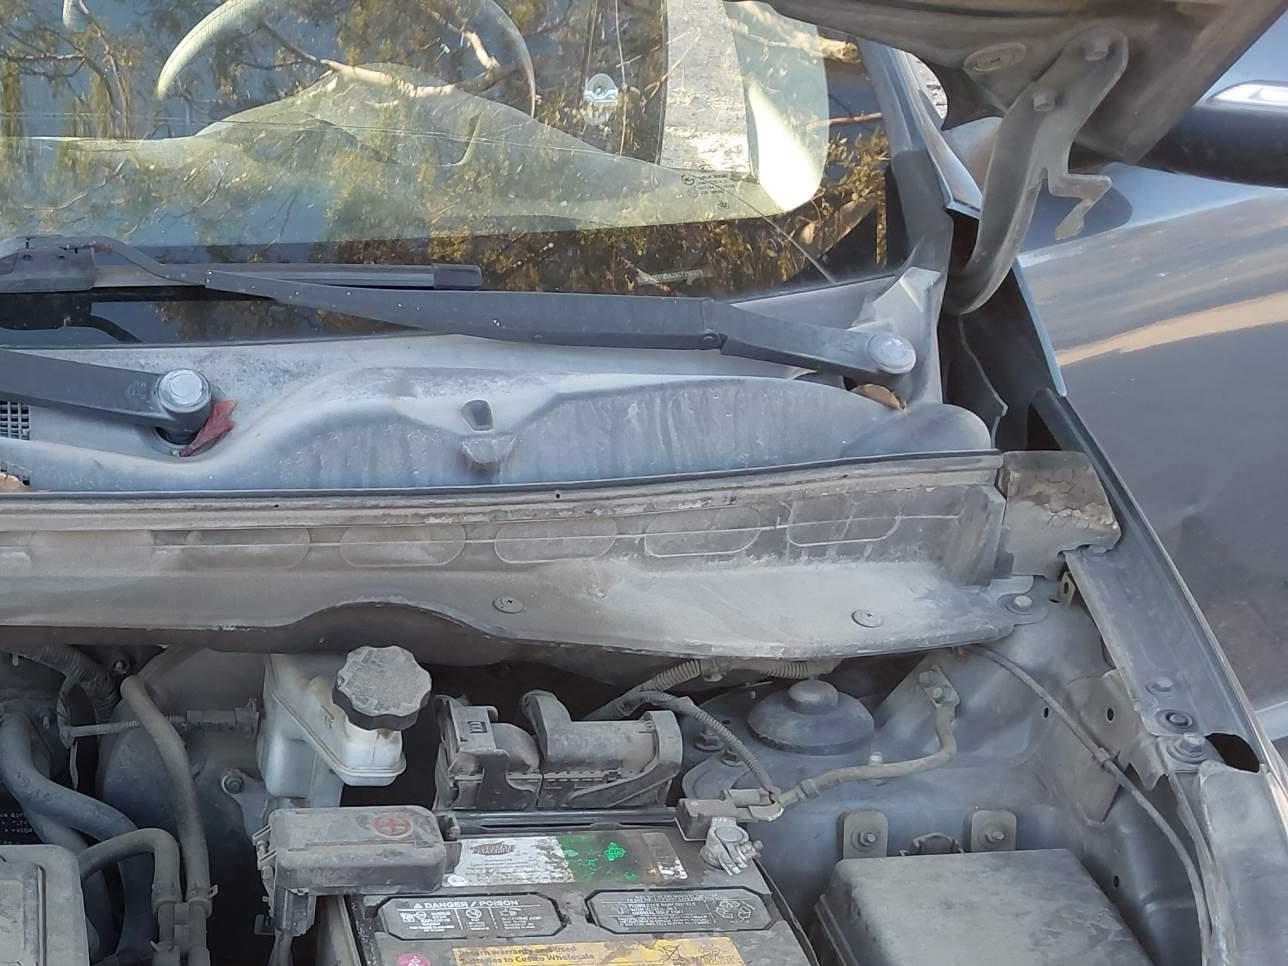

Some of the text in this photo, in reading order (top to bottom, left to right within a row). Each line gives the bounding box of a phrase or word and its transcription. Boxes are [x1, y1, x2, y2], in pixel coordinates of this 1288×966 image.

[424, 901, 469, 909] DANGER
[478, 899, 519, 907] POISON
[503, 955, 514, 963] to
[546, 952, 595, 961] Wholesale
